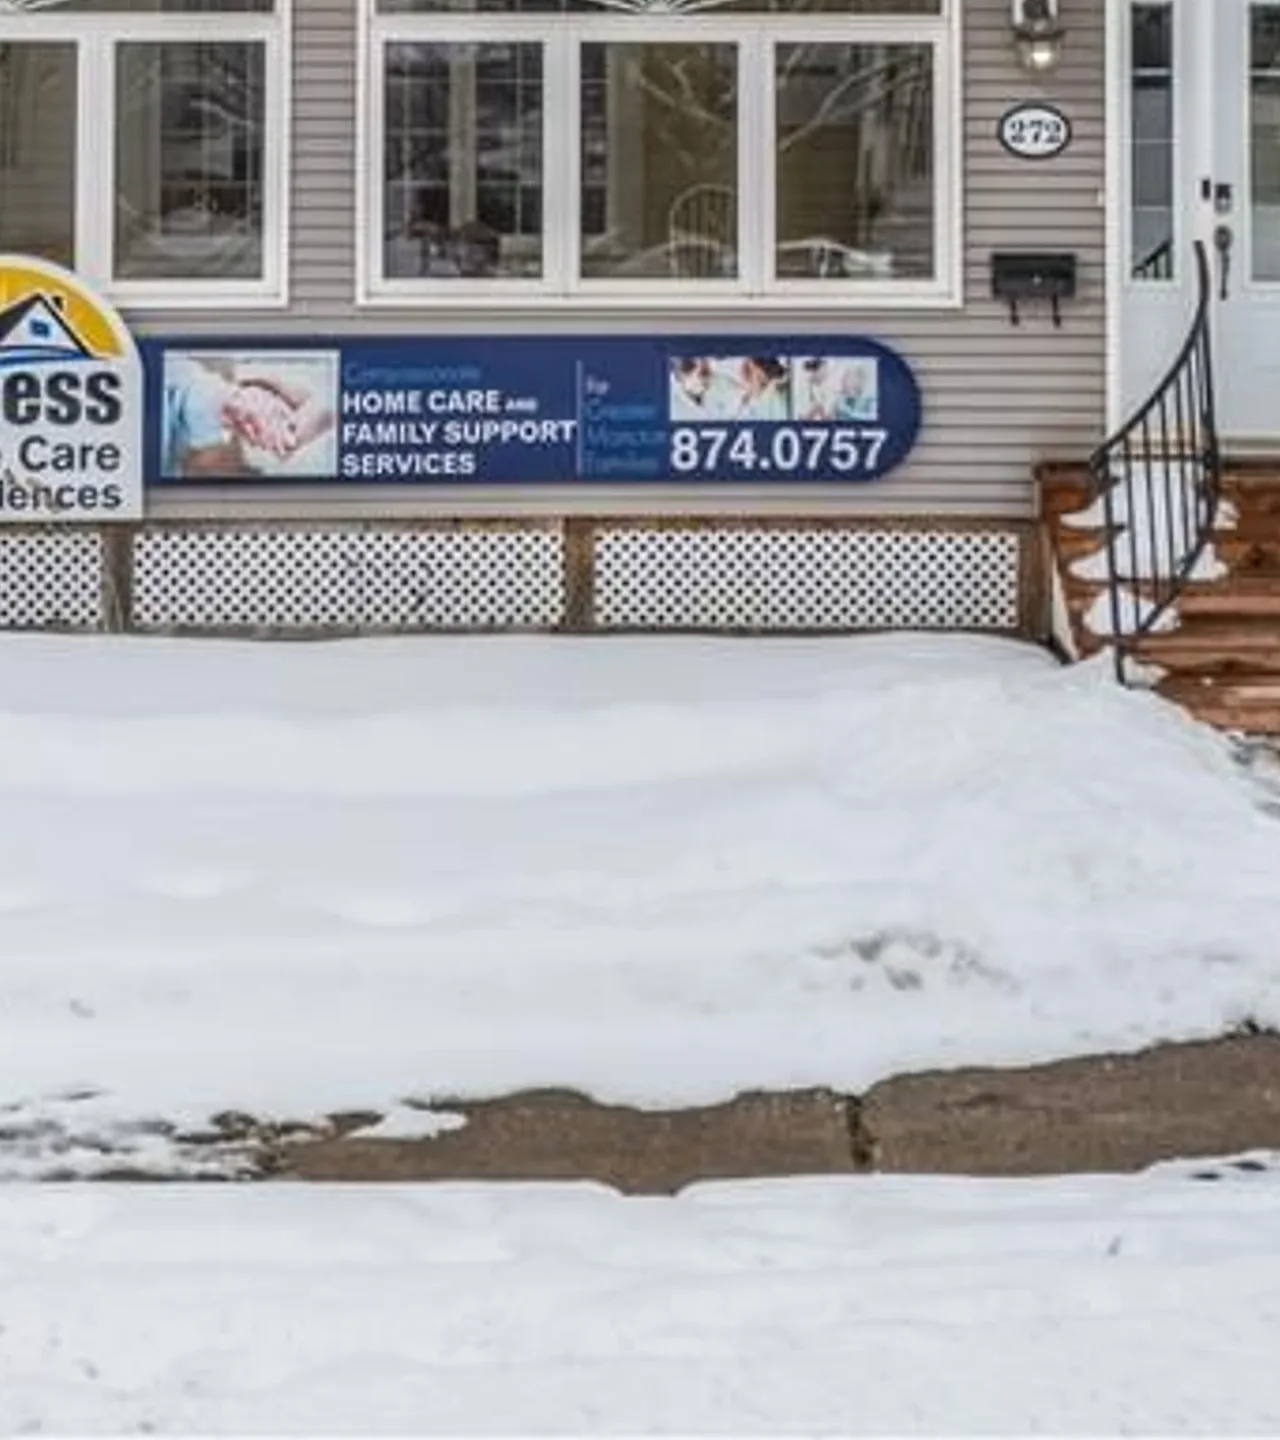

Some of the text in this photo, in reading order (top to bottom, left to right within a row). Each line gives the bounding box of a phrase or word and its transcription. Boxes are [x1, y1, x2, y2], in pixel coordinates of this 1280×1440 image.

[1010, 119, 1061, 144] 272
[342, 392, 419, 413] HOME
[429, 390, 501, 412] CARE
[342, 420, 577, 444] FAMILY SUPPORT
[21, 436, 121, 472] Care
[671, 427, 888, 470] 874.0757
[342, 453, 477, 475] SERVICES
